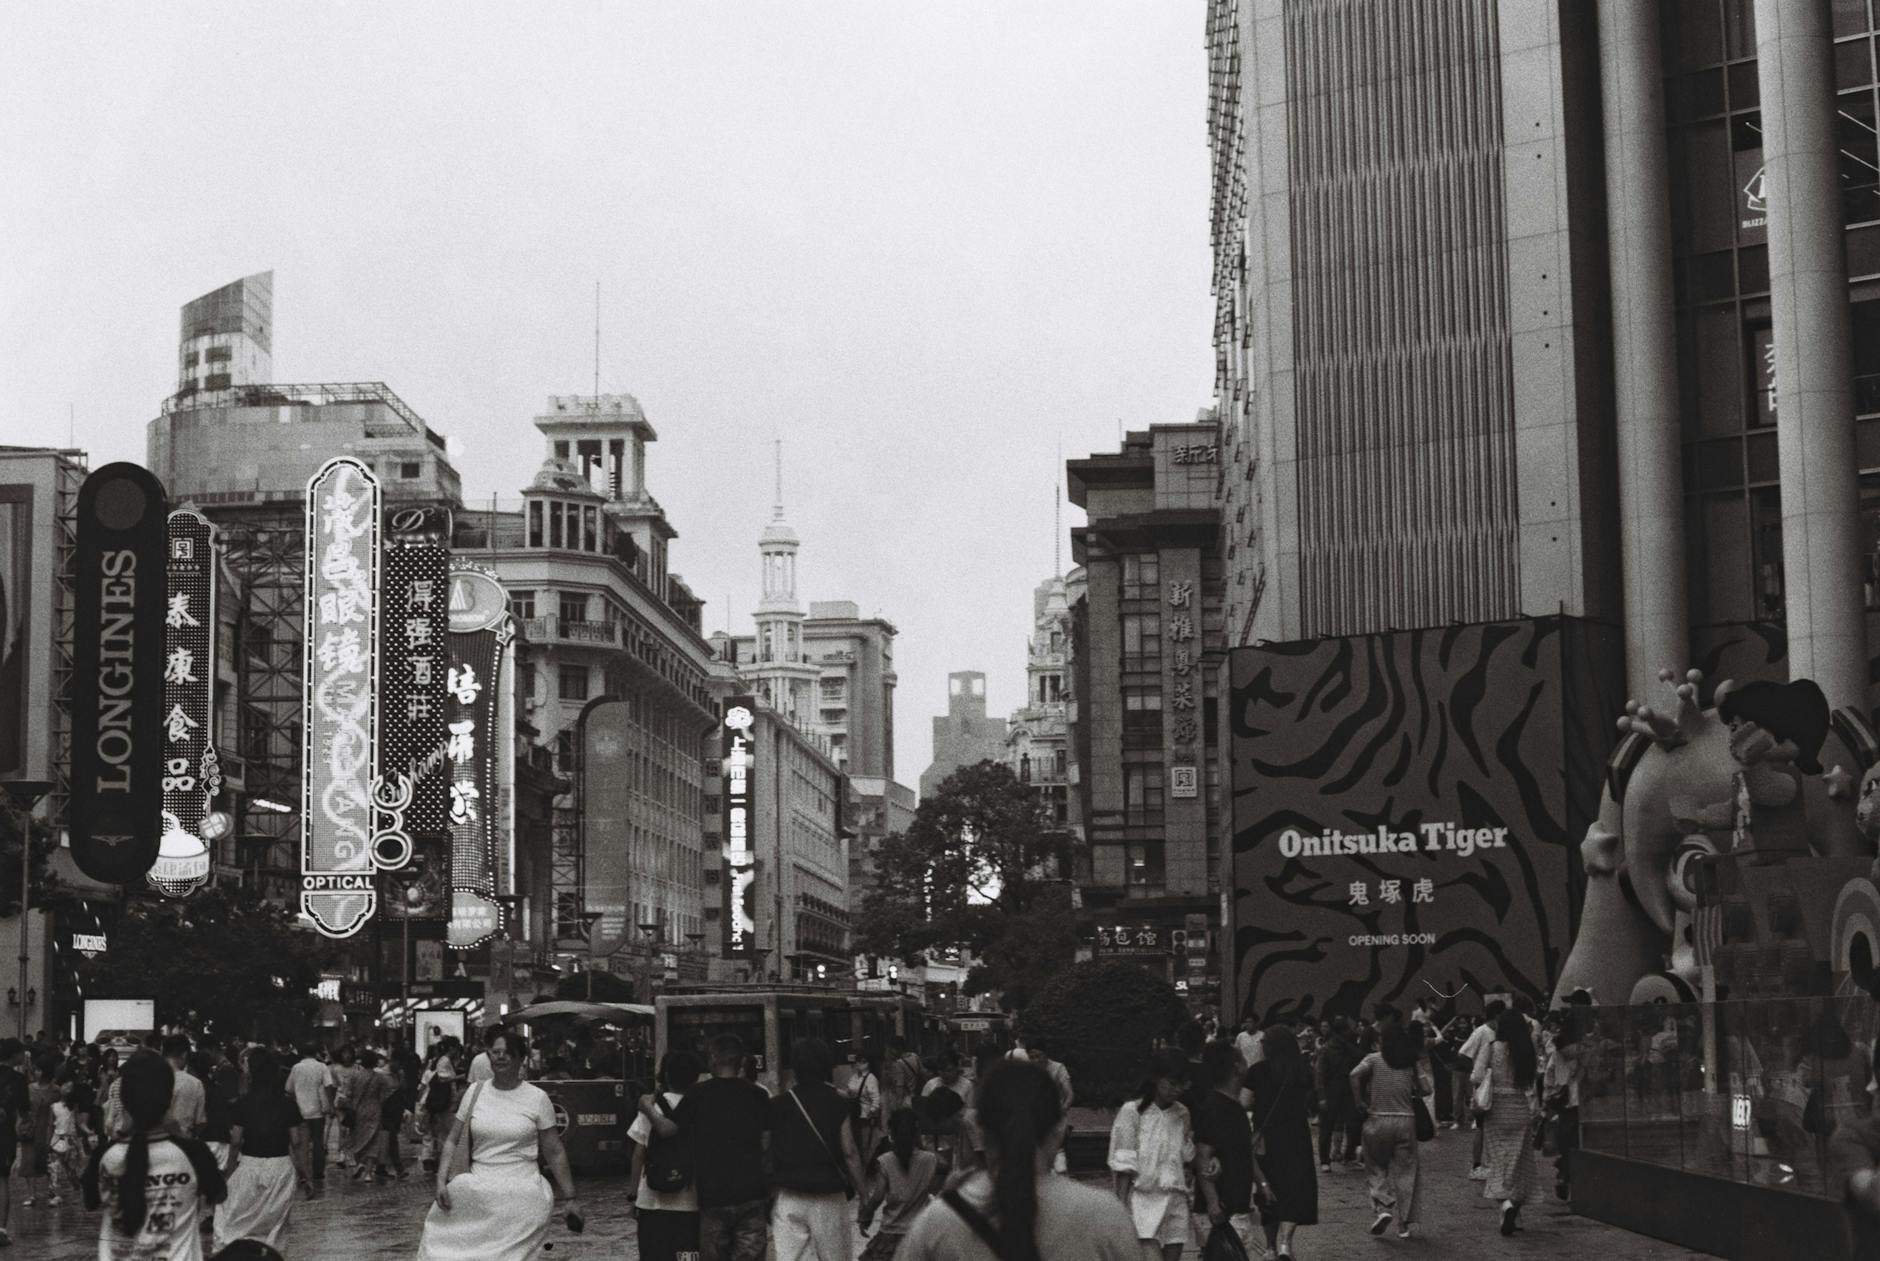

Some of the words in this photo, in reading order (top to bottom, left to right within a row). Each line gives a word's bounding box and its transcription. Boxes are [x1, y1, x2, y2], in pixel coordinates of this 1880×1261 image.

[1741, 217, 1768, 229] BLIZZ
[448, 614, 486, 623] ROMON
[96, 549, 137, 795] LONGINES
[161, 591, 201, 792] 泰康食品
[1278, 824, 1417, 858] Onitsuka
[1421, 821, 1509, 858] Tiger
[302, 876, 374, 890] OPTICAL
[1348, 877, 1436, 906] 鬼塚虎
[1348, 933, 1400, 946] OPENING
[1402, 933, 1436, 945] SOON
